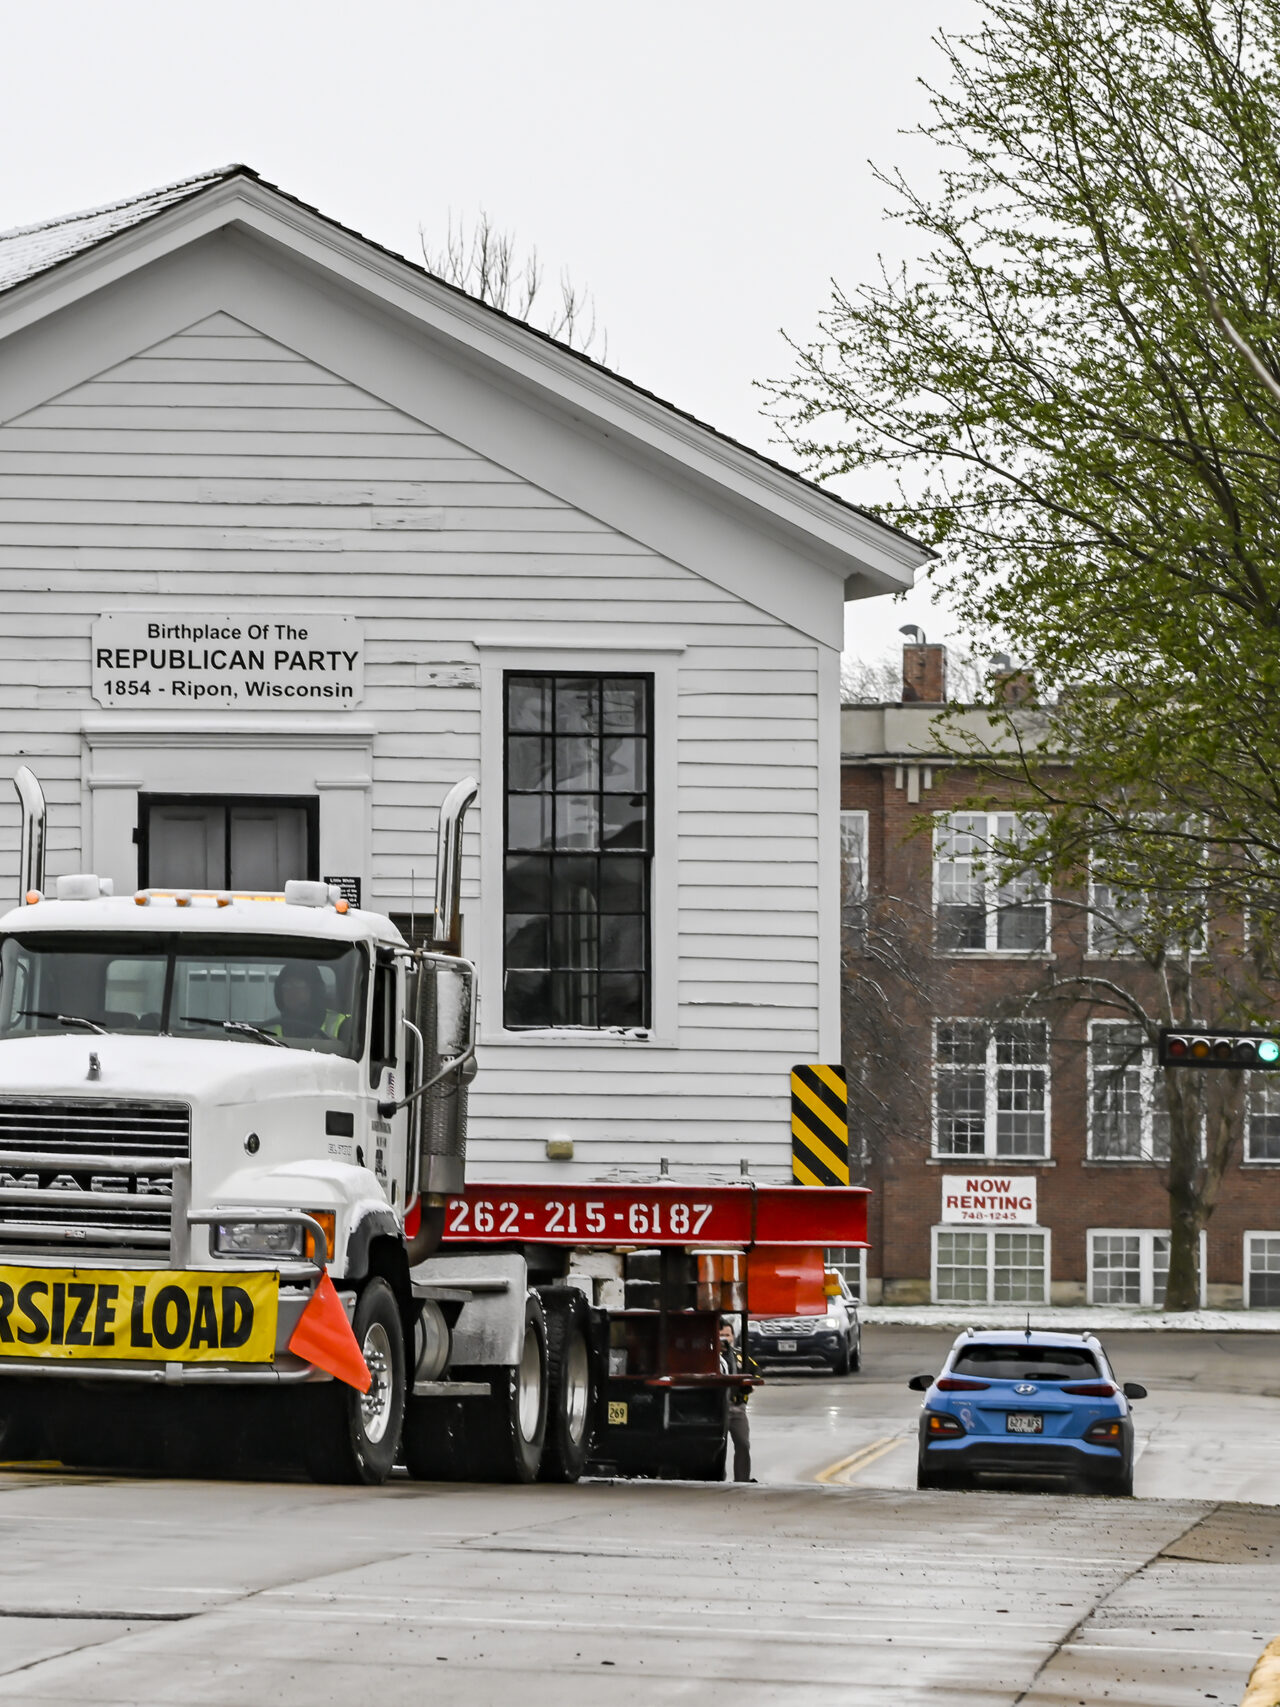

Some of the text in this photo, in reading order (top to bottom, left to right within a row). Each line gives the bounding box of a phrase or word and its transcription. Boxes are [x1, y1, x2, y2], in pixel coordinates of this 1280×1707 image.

[148, 623, 308, 643] Birthplace Of The
[96, 648, 359, 671] REPUBLICAN PARTY
[103, 680, 151, 696] 1854
[172, 680, 238, 699] Ripon,
[245, 681, 353, 698] Wisconsin
[966, 1179, 1011, 1193] NOW
[946, 1195, 1032, 1210] RENTING
[130, 1284, 255, 1349] LOAD
[609, 1407, 625, 1419] 269
